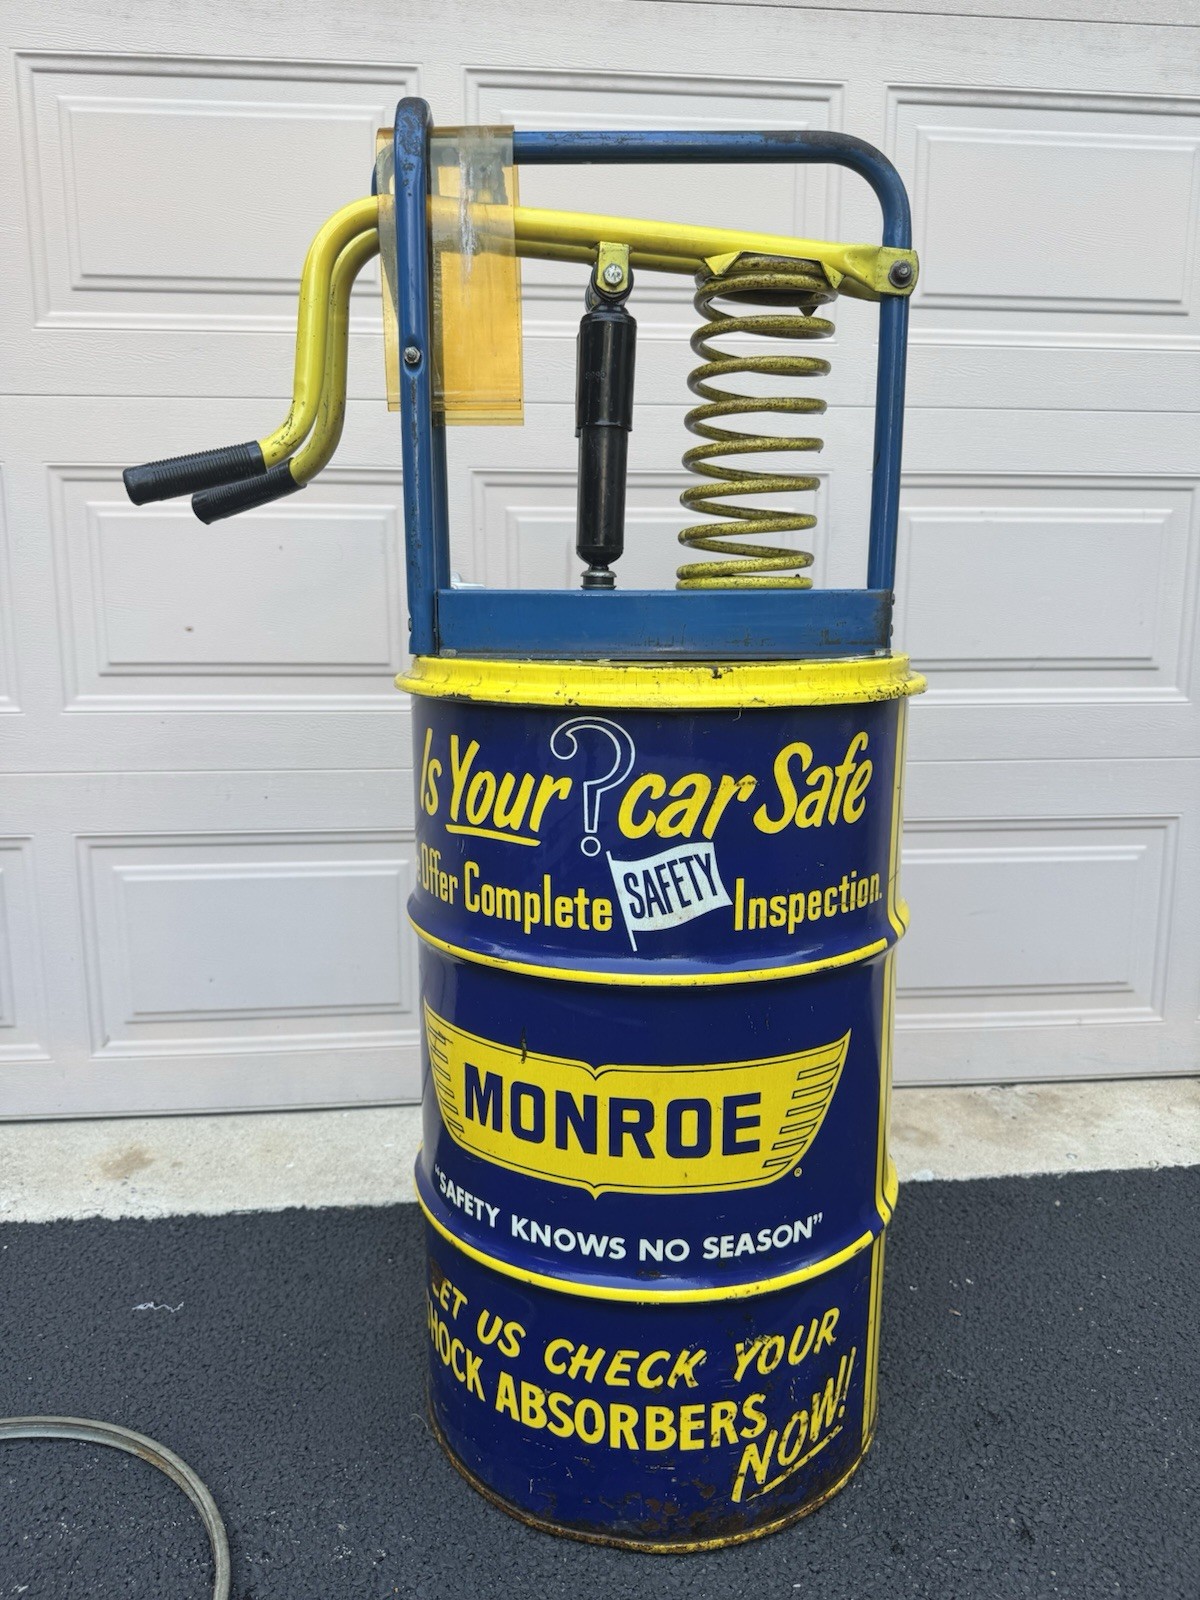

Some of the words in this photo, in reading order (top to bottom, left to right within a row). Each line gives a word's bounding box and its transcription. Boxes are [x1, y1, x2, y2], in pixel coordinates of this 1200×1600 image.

[420, 727, 441, 816] Is
[447, 734, 572, 832] Your
[618, 772, 757, 840] car
[753, 731, 874, 834] Safe
[421, 842, 459, 906] Offer
[464, 861, 613, 934] Complete
[623, 853, 718, 920] SAFETY
[734, 871, 882, 934] Inspection.
[464, 1062, 761, 1160] MONROE
[511, 1215, 627, 1260] KNOWS
[639, 1238, 690, 1262] NO
[476, 1309, 527, 1358] US
[543, 1337, 707, 1389] CHECK
[733, 1307, 841, 1383] YOUR
[494, 1370, 768, 1452] ABSORBERS
[730, 1346, 858, 1504] NOW!!
